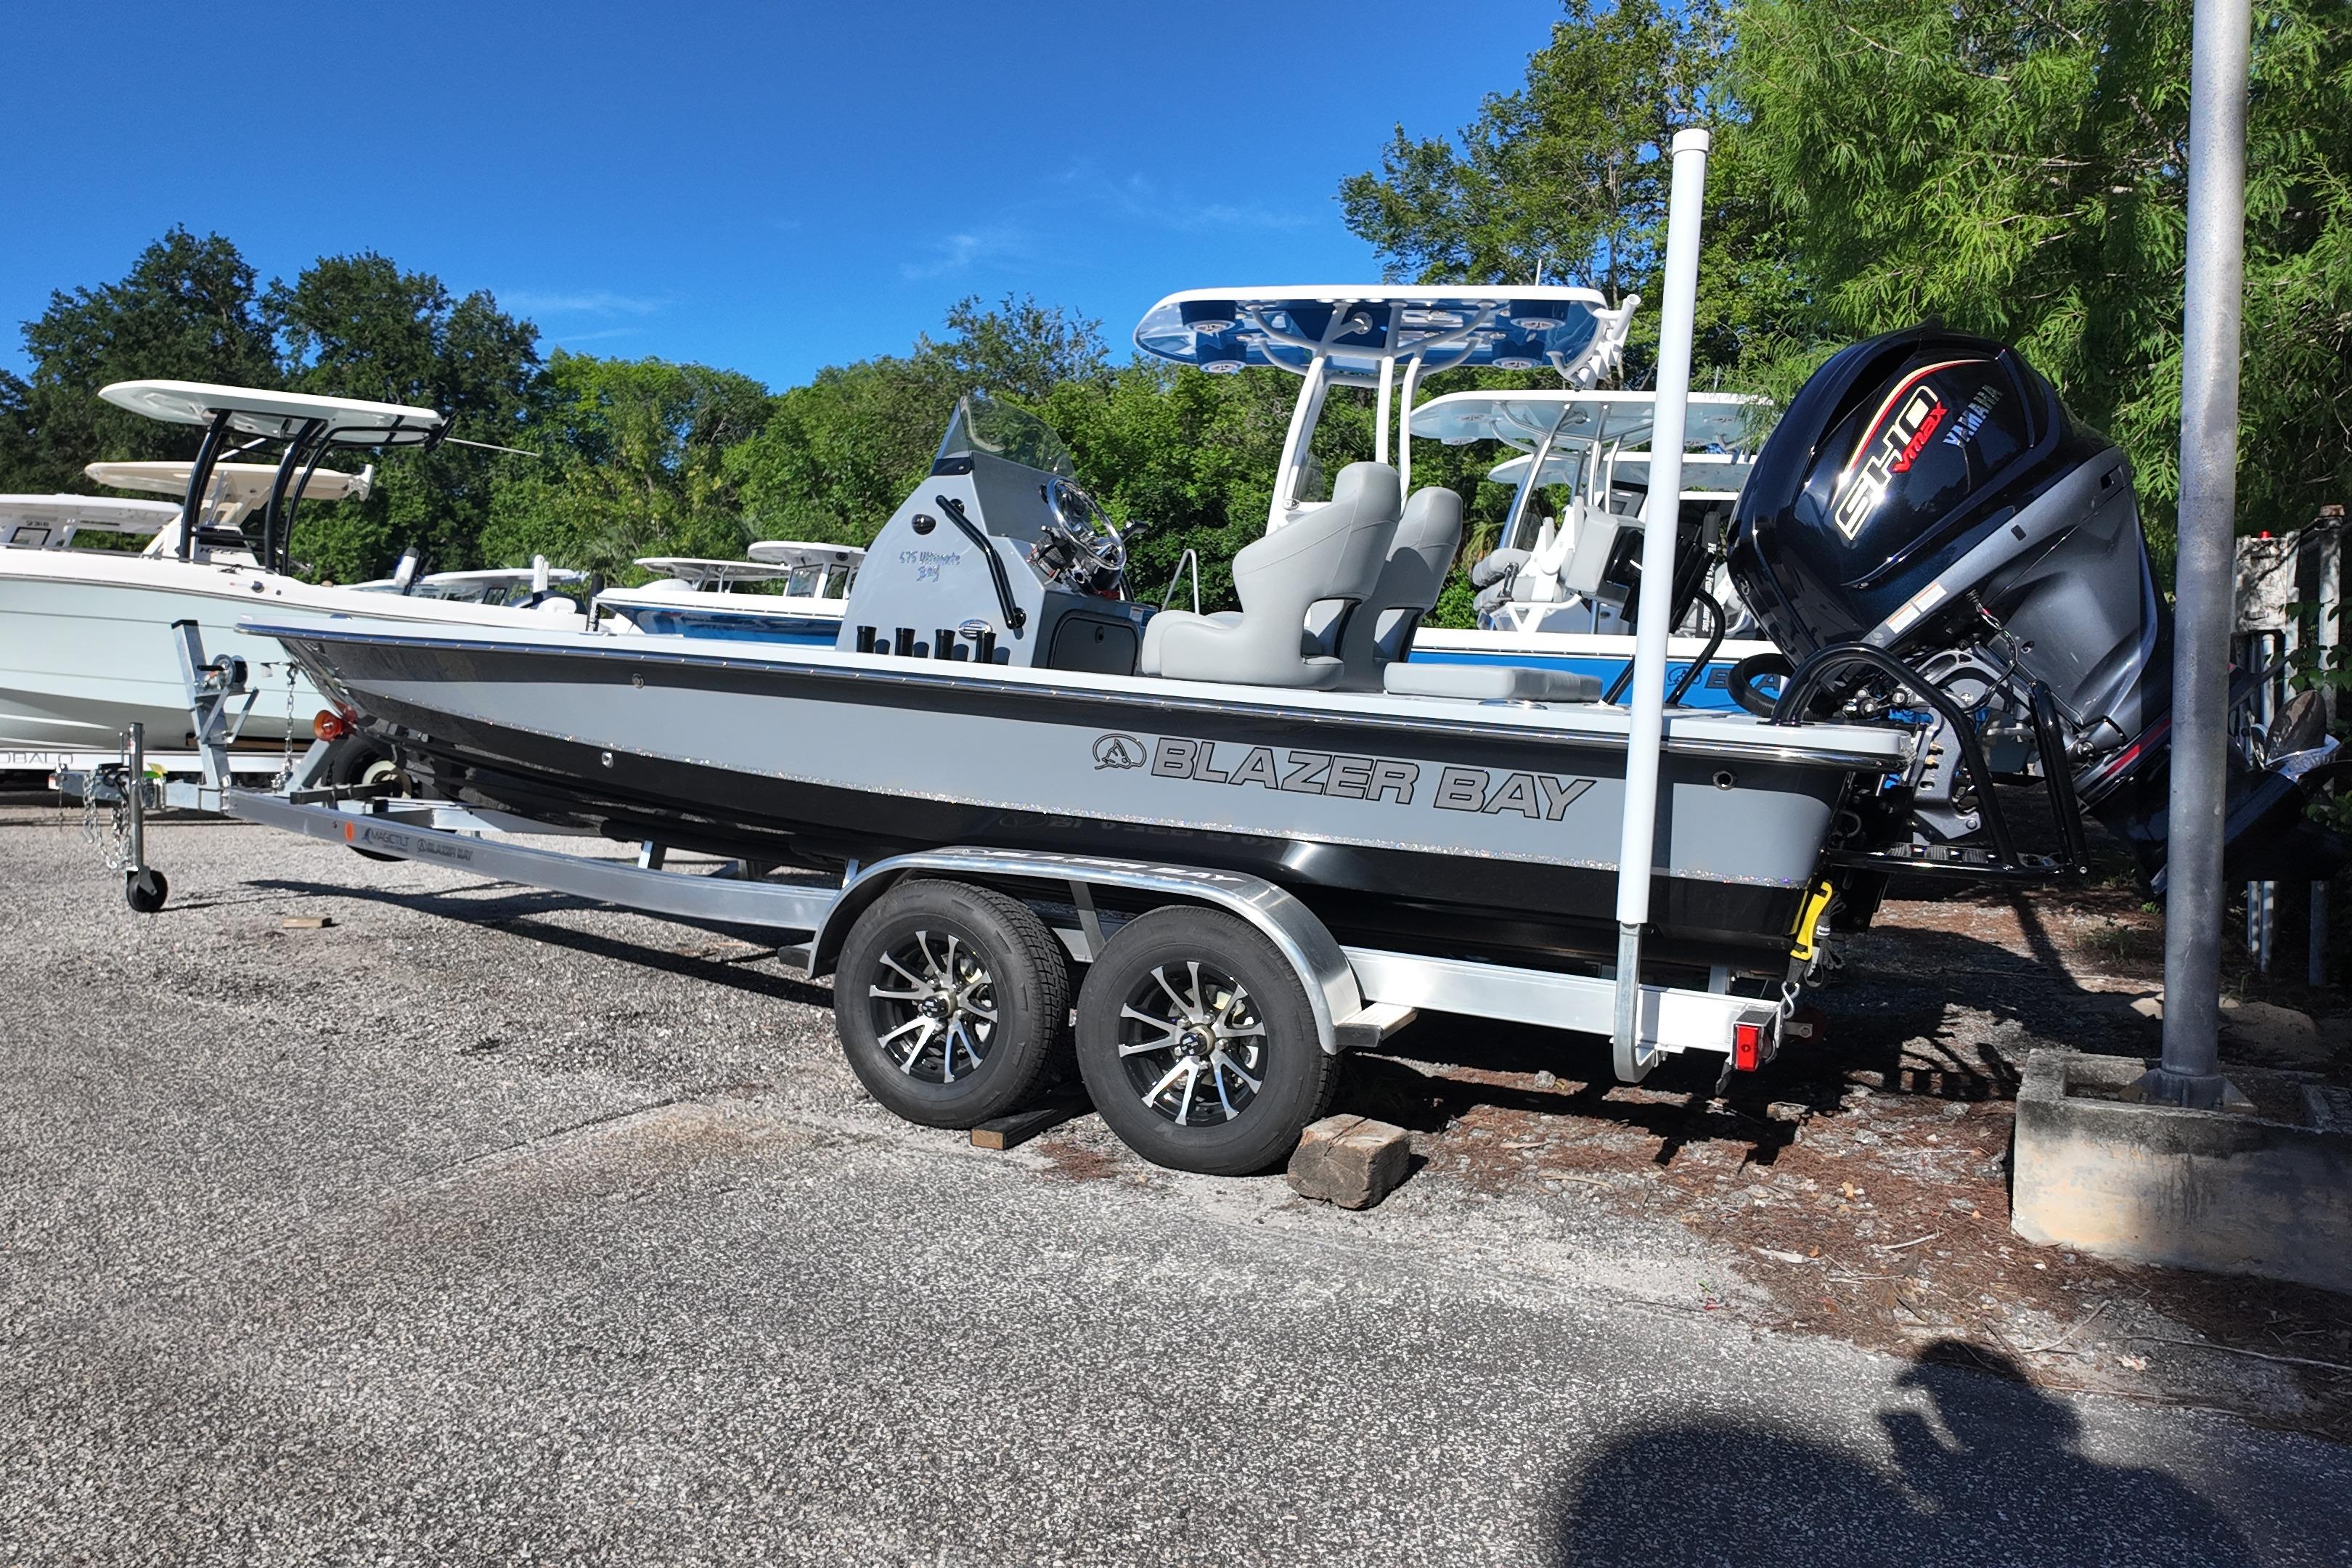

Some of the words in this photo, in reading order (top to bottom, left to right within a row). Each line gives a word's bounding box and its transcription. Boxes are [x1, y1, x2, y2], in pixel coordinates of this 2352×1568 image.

[1943, 384, 2004, 449] YAMAHA
[1834, 385, 1939, 541] SHO
[1151, 737, 1420, 805] BLAZER
[1433, 766, 1598, 821] BAY
[988, 851, 1149, 870] BLAZER
[1149, 867, 1248, 883] BAY
